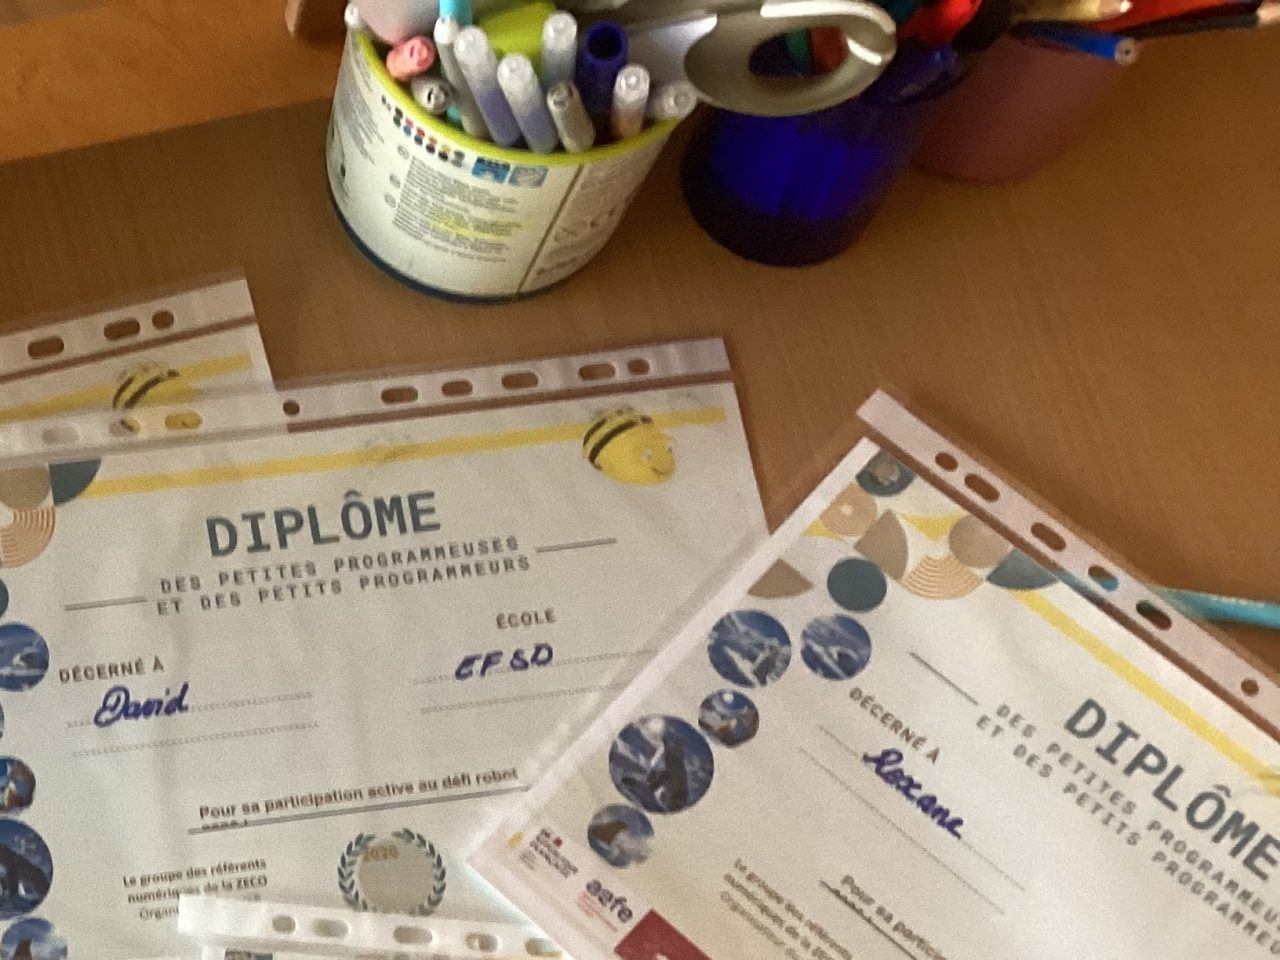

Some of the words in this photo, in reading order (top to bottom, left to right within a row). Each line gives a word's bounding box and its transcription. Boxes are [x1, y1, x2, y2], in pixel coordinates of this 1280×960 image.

[205, 488, 441, 558] DIPLÔME
[157, 598, 184, 616] ET
[200, 591, 242, 611] DES
[258, 579, 343, 603] PETITS
[360, 555, 530, 591] PROGRAMMEURS
[160, 575, 201, 594] DES
[219, 560, 317, 587] PETITES
[334, 535, 519, 573] PROGRAMMEUSES
[59, 658, 144, 684] DÉCERNÉ
[93, 681, 190, 728] David
[976, 714, 1006, 738] ET
[1012, 744, 1054, 778] DES
[1062, 782, 1142, 846] PETITS
[996, 704, 1037, 738] DES
[1046, 742, 1136, 815] PETITES
[199, 804, 237, 821] Pour
[241, 801, 261, 814] sa
[264, 786, 364, 815] participation
[367, 780, 414, 800] active
[419, 779, 438, 793] au
[442, 772, 471, 790] défi
[474, 767, 520, 785] robot
[1064, 698, 1280, 882] DIPLÔME
[840, 874, 875, 906] Pour
[876, 905, 894, 923] sa
